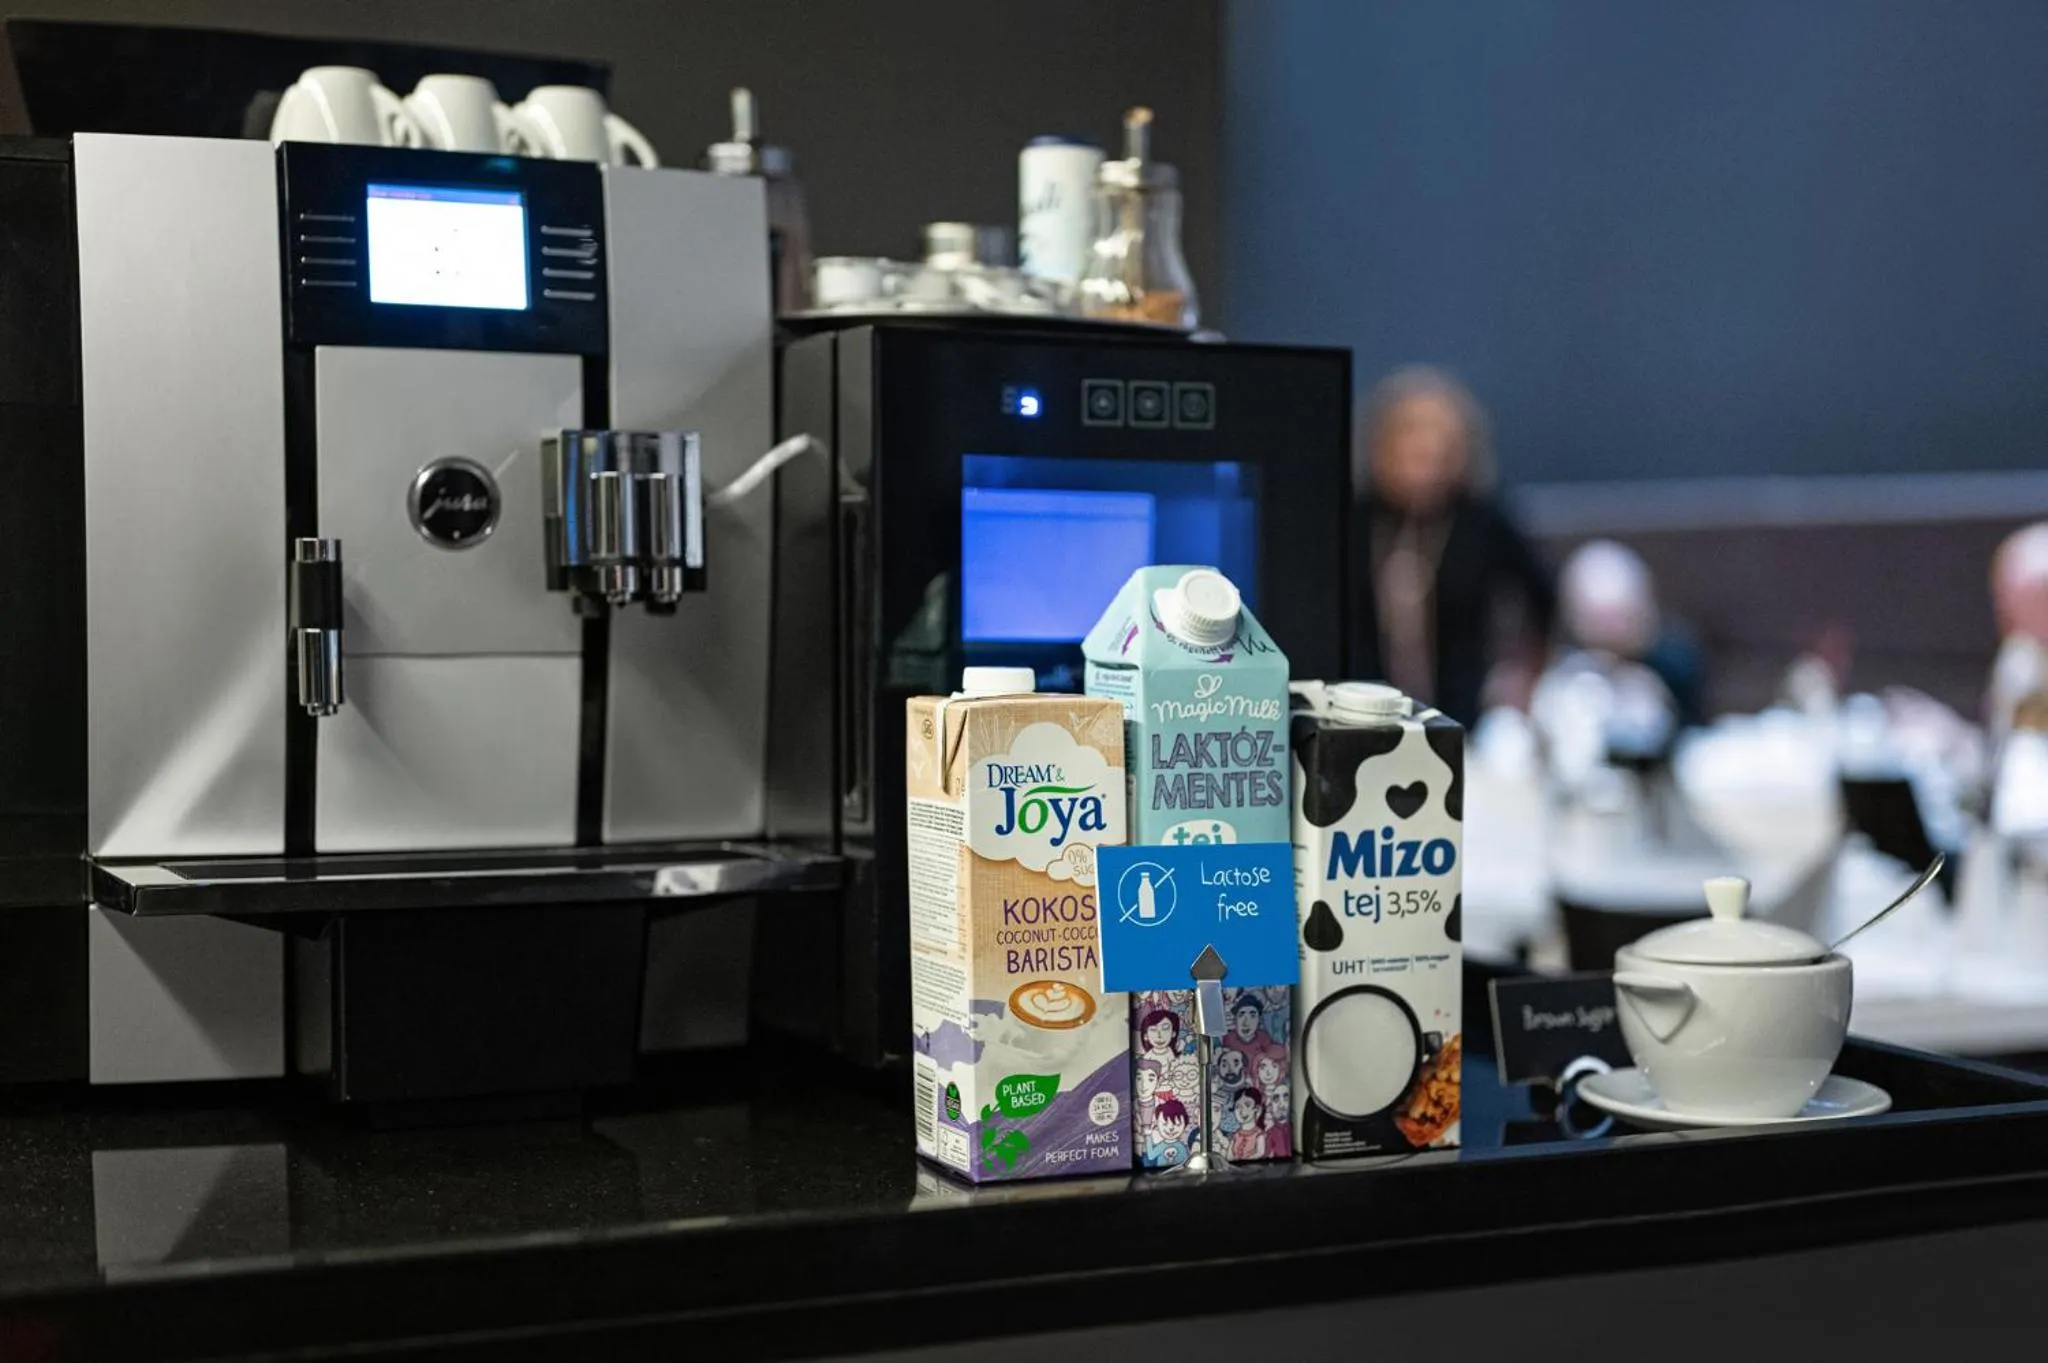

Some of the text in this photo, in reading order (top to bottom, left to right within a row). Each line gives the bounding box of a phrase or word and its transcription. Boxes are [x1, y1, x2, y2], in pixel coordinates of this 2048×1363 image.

[1151, 726, 1286, 770] LAKTÓZ-
[986, 763, 1052, 788] DREAM
[1152, 770, 1284, 810] MENTES
[994, 787, 1107, 847] Joya
[1326, 826, 1456, 880] Mizo
[1200, 861, 1272, 887] Lactose
[1003, 894, 1097, 926] KOKOS
[1217, 892, 1260, 923] free
[1343, 885, 1441, 924] tej 3,5%
[996, 928, 1057, 946] COCONUT
[1006, 945, 1098, 974] BARISTA
[1332, 959, 1365, 975] UHT
[1002, 1080, 1036, 1097] PLANT
[1011, 1093, 1046, 1109] BASED
[1085, 1131, 1119, 1146] MAKES
[1045, 1146, 1119, 1164] PERFECT FOAM
